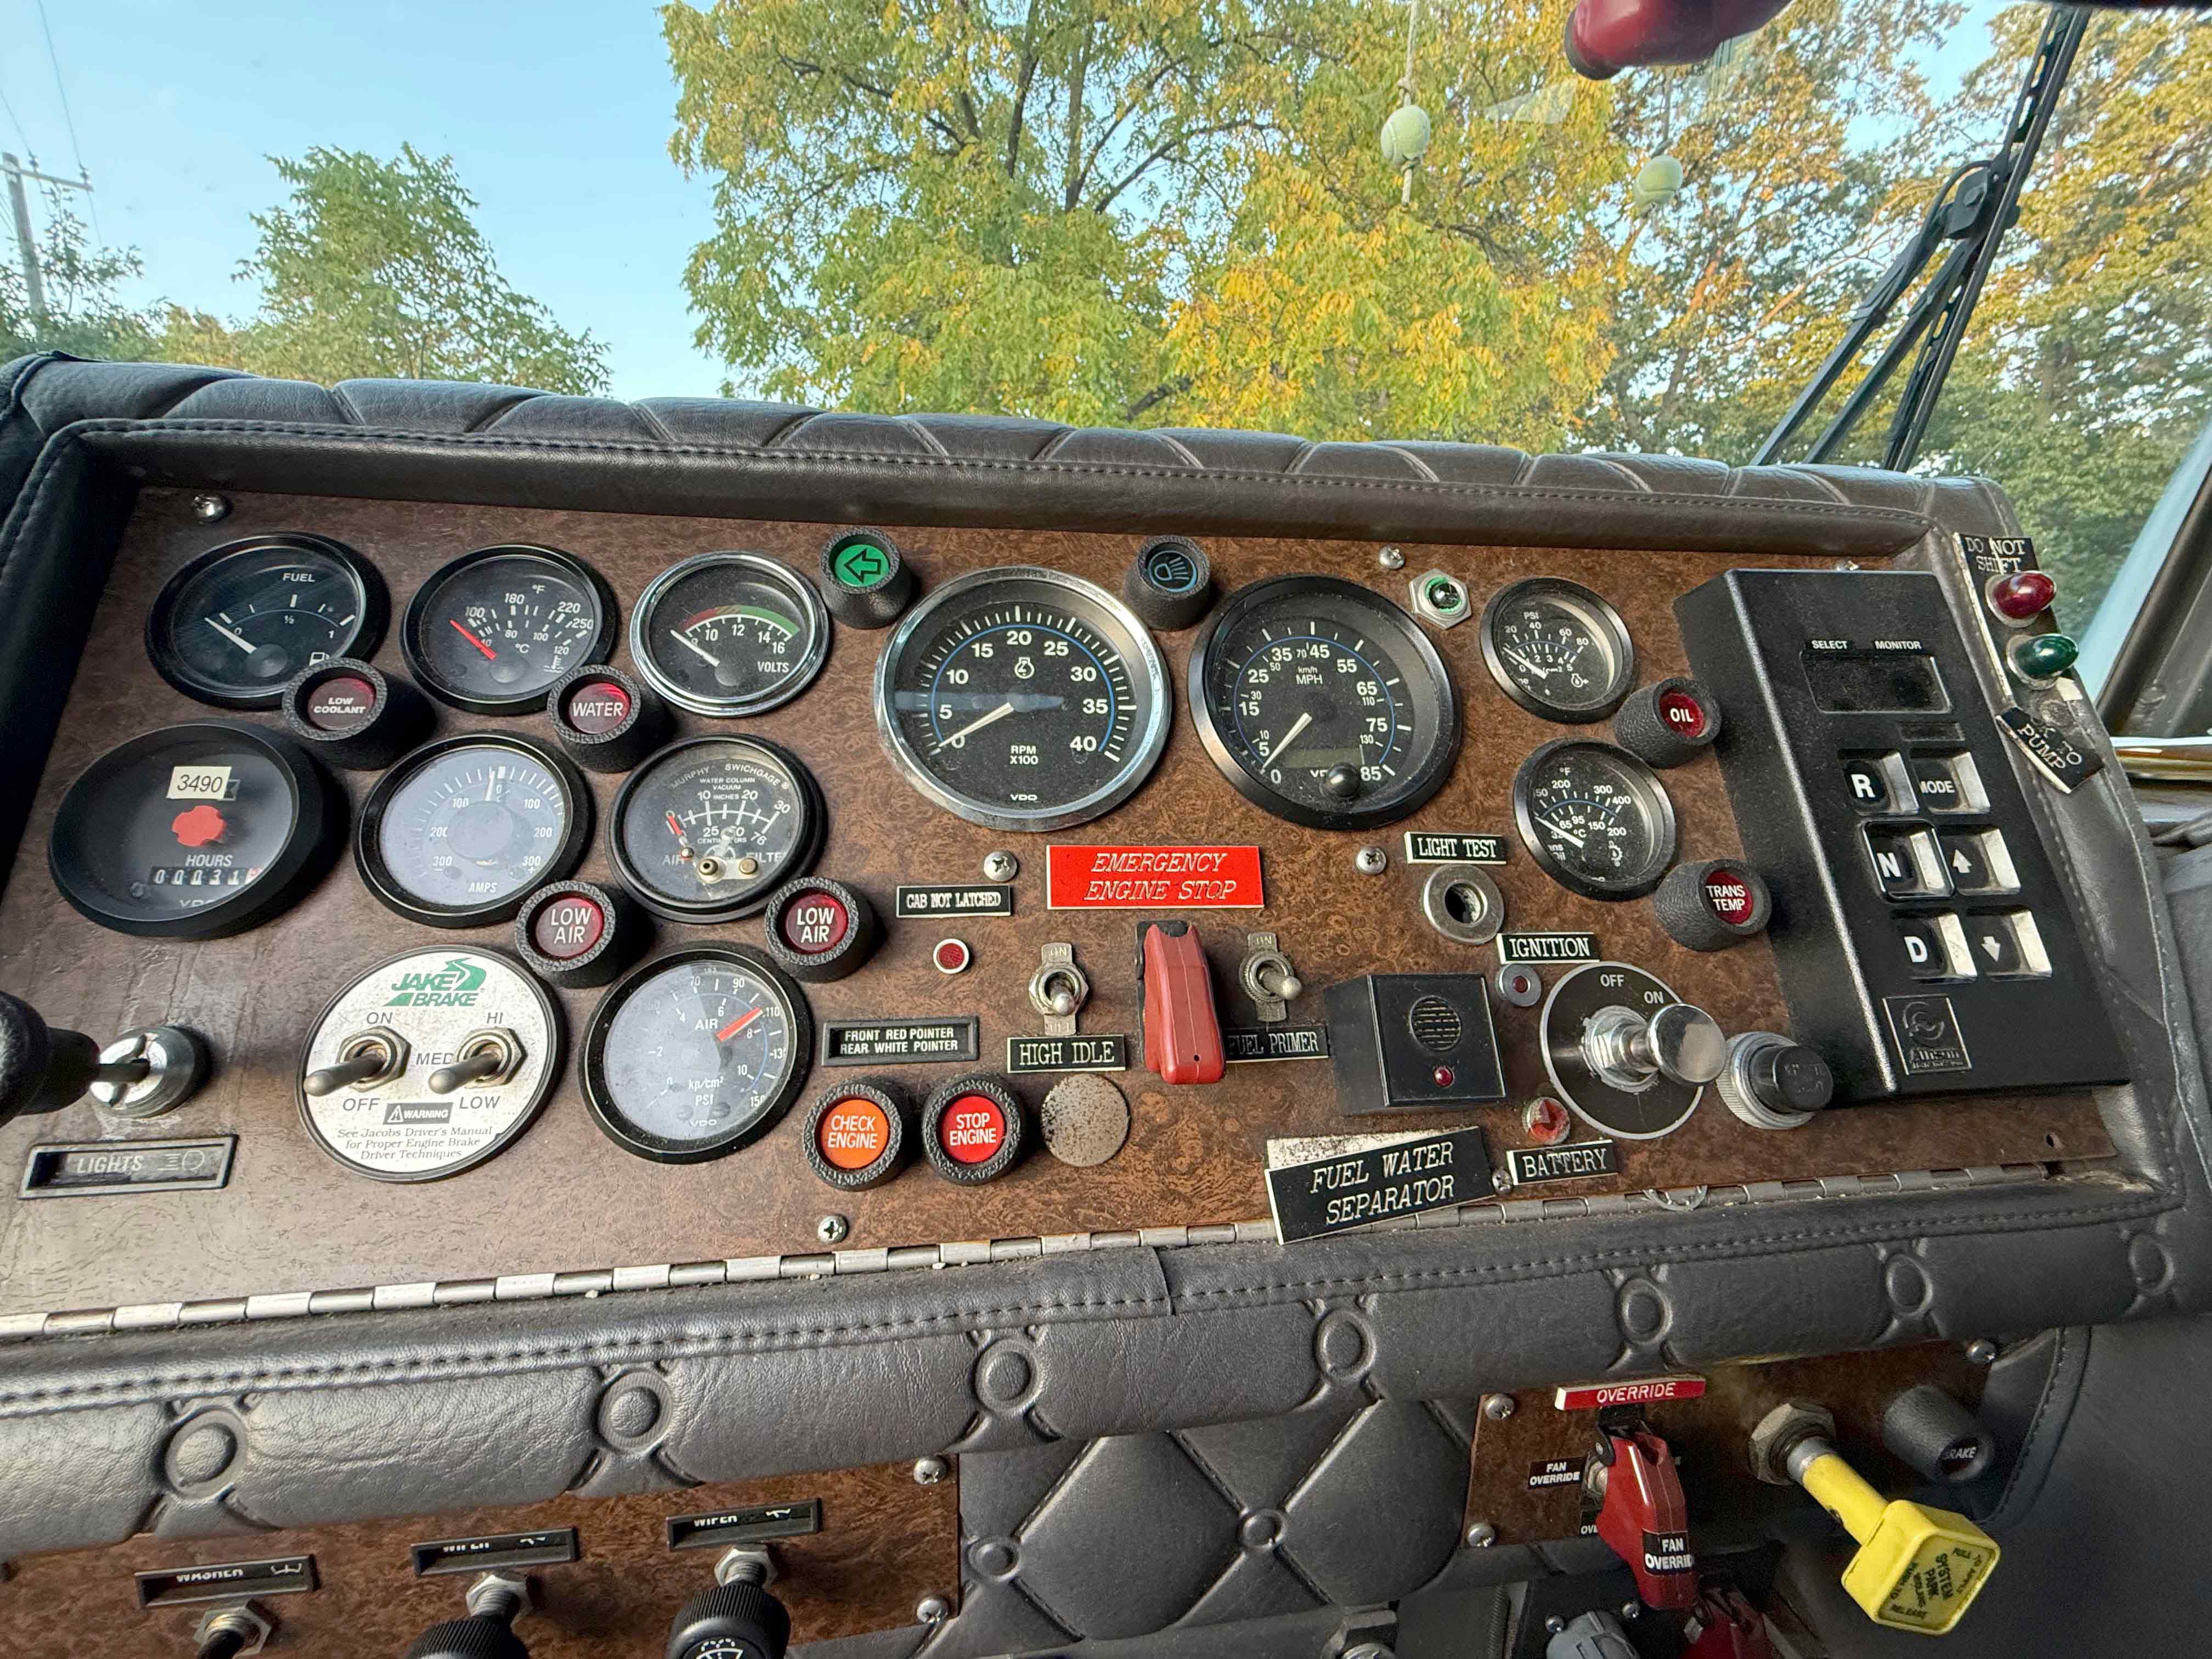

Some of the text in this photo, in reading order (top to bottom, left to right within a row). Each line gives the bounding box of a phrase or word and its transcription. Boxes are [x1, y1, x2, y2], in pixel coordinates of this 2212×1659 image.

[1965, 537, 2025, 555] DO NOT
[1976, 556, 2022, 573] SHIFT
[283, 573, 315, 582] FUEL
[505, 593, 525, 603] 180
[465, 607, 485, 617] 100
[557, 602, 580, 613] 220
[573, 619, 594, 629] 250
[732, 625, 744, 636] 12
[706, 629, 718, 641] 10
[758, 633, 770, 643] 14
[1007, 631, 1031, 645] 20
[554, 646, 568, 654] 120
[772, 642, 785, 653] 16
[972, 644, 994, 658] 15
[1044, 642, 1069, 656] 25
[1310, 645, 1330, 658] 45
[1812, 640, 1921, 650] SELECT MONITOR
[1272, 648, 1293, 661] 35
[1296, 650, 1306, 658] 70
[758, 662, 789, 673] VOLTS
[1269, 663, 1280, 671] 50
[1337, 659, 1357, 673] 55
[947, 670, 969, 684] 10
[1071, 668, 1096, 681] 30
[1248, 669, 1269, 683] 25
[1296, 674, 1323, 684] MPH
[1357, 681, 1378, 695] 65
[1251, 691, 1261, 699] 30
[314, 706, 365, 714] COOLANT
[572, 702, 623, 716] WATER
[940, 706, 952, 719] 5
[1083, 699, 1108, 713] 35
[1239, 702, 1260, 716] 15
[1670, 708, 1694, 723] OIL
[1366, 718, 1387, 732] 75
[1260, 731, 1269, 740] 10
[1011, 746, 1036, 755] RPM
[1070, 737, 1096, 752] 40
[1259, 743, 1269, 757] 5
[2017, 723, 2066, 769] PUMP
[1010, 755, 1039, 765] X100
[671, 763, 780, 788] MURPHY SWICHGAGE
[1271, 770, 1281, 784] 0
[1361, 767, 1381, 781] 85
[177, 774, 223, 793] 3490
[1551, 780, 1570, 788] 200
[1594, 786, 1612, 794] 300
[1851, 774, 1875, 798] R
[1920, 780, 1955, 794] MODE
[698, 791, 711, 800] 10
[741, 790, 758, 800] 20
[453, 798, 469, 808] 100
[524, 798, 540, 809] 100
[774, 800, 790, 814] 30
[1559, 821, 1572, 829] 65
[1588, 822, 1605, 830] 150
[534, 827, 552, 837] 200
[703, 827, 719, 837] 25
[1607, 828, 1627, 836] 200
[751, 832, 767, 846] 76
[1417, 838, 1497, 858] LIGHT TEST
[185, 855, 234, 867] HOURS
[432, 856, 452, 866] 300
[522, 856, 541, 866] 300
[1091, 853, 1228, 873] EMERGENCY
[1877, 853, 1901, 877] N
[468, 882, 498, 893] AMPS
[1084, 880, 1237, 901] ENGINE STOP
[1706, 885, 1745, 898] TRANS
[906, 891, 1001, 908] CAB NOT LATCHED
[1713, 899, 1745, 911] TEMP
[550, 908, 592, 926] LOW
[797, 909, 835, 926] LOW
[554, 927, 585, 944] AIR
[800, 927, 831, 943] AIR
[1509, 938, 1590, 957] IGNITION
[1904, 936, 1928, 962] D
[391, 973, 457, 991] JAKE
[733, 978, 744, 988] 90
[1600, 974, 1624, 987] OFF
[411, 992, 479, 1007] BRAKE
[1644, 991, 1664, 1004] ON
[366, 1012, 393, 1025] ON
[486, 1013, 504, 1024] HI
[695, 1019, 718, 1030] AIR
[845, 1028, 954, 1041] FRONT RED POINTER
[840, 1040, 958, 1054] REAR WHITE POINTER
[1228, 1031, 1319, 1054] FUEL PRIMER
[416, 1053, 454, 1065] MED
[1019, 1041, 1115, 1065] HIGH IDLE
[737, 1065, 747, 1076] 10
[342, 1098, 381, 1111] OFF
[459, 1096, 500, 1109] LOW
[695, 1094, 713, 1107] PSI
[404, 1110, 449, 1119] WARNING
[956, 1113, 990, 1127] STOP
[831, 1115, 877, 1131] CHECK
[337, 1126, 493, 1138] See Jacobs Driver's Manual
[949, 1128, 997, 1146] ENGINE
[346, 1138, 481, 1150] for Proper Engine Brake
[827, 1132, 878, 1149] ENGINE
[361, 1149, 461, 1160] Driver Techniques
[76, 1155, 143, 1173] LIGHTS
[1310, 1141, 1454, 1194] FUEL WATER
[1522, 1149, 1609, 1177] BATTERY
[1325, 1175, 1455, 1226] SEPARATOR
[1596, 1382, 1677, 1404] OVERRIDE
[1546, 1462, 1567, 1472] FAN
[1529, 1471, 1580, 1486] OVERRIDE
[1662, 1538, 1684, 1552] FAN
